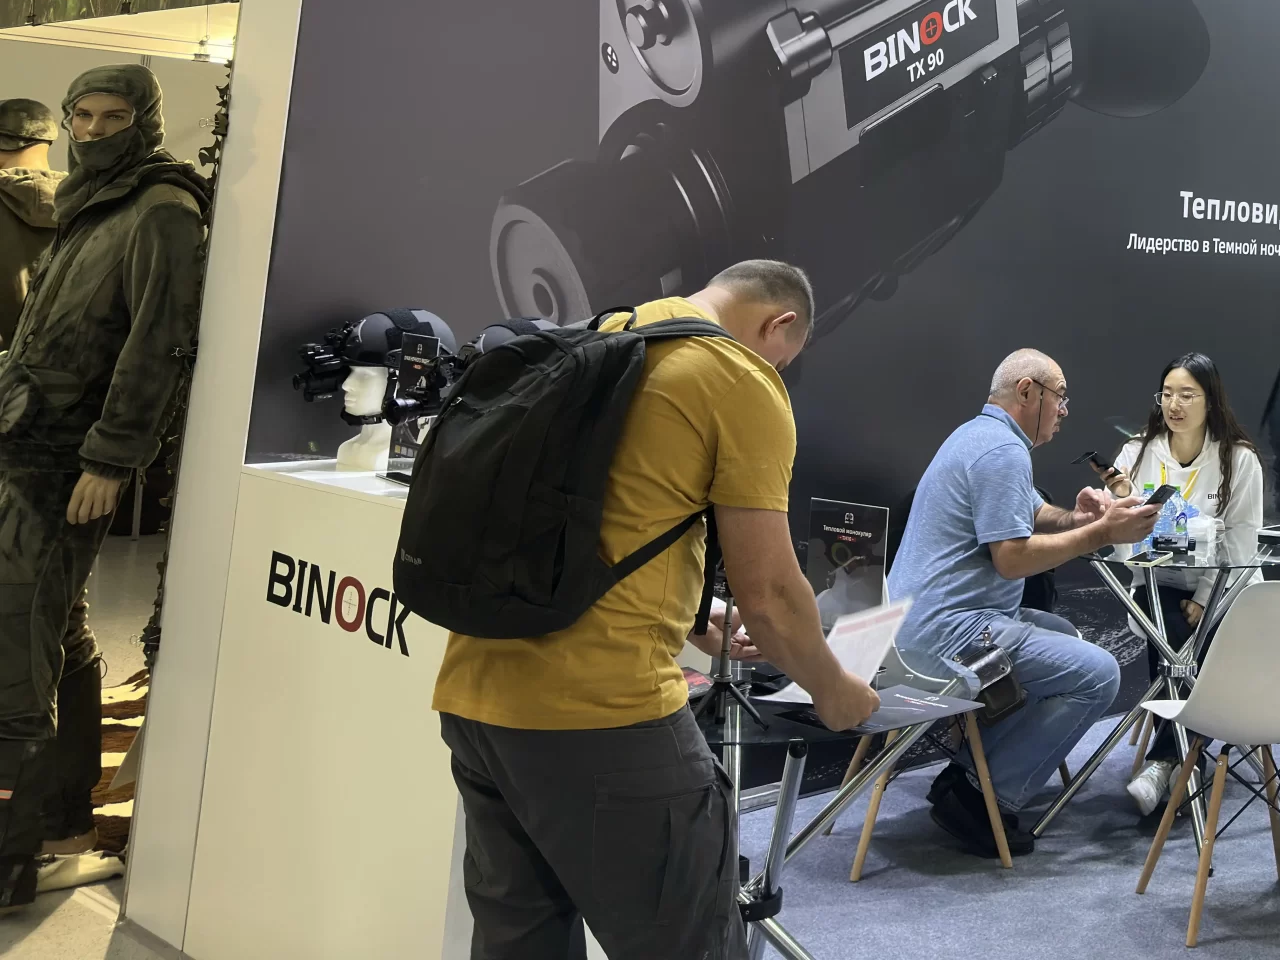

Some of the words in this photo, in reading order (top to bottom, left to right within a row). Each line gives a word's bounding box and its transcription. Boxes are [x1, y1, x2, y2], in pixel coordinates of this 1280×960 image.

[907, 58, 926, 82] TX
[927, 48, 944, 71] 90
[1127, 233, 1199, 255] Лидерство
[1203, 241, 1210, 253] в
[1213, 238, 1257, 255] Темной
[266, 550, 409, 657] BINOCK
